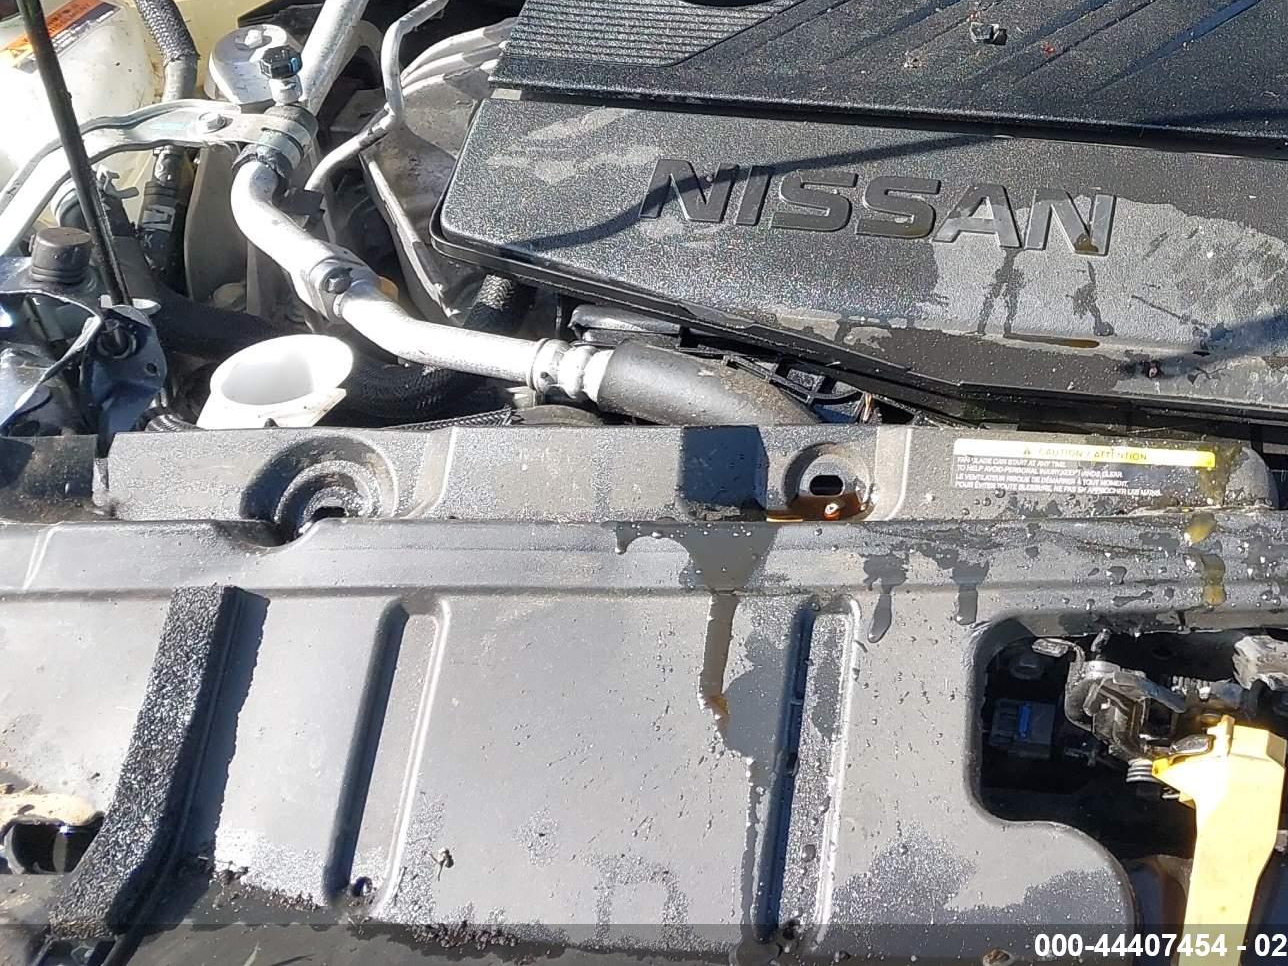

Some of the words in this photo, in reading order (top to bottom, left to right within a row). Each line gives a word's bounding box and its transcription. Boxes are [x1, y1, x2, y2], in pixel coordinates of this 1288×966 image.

[638, 159, 1117, 257] NISSAN
[1039, 448, 1083, 457] CAUTION
[993, 457, 1007, 465] CAN
[1007, 458, 1027, 466] START
[1027, 459, 1037, 467] AT
[1037, 459, 1051, 467] ANY
[955, 480, 974, 488] POUR
[997, 482, 1017, 491] TOUTE
[965, 474, 1006, 482] VENTILATEUR
[1031, 476, 1040, 484] DE
[1082, 478, 1099, 486] TOUT
